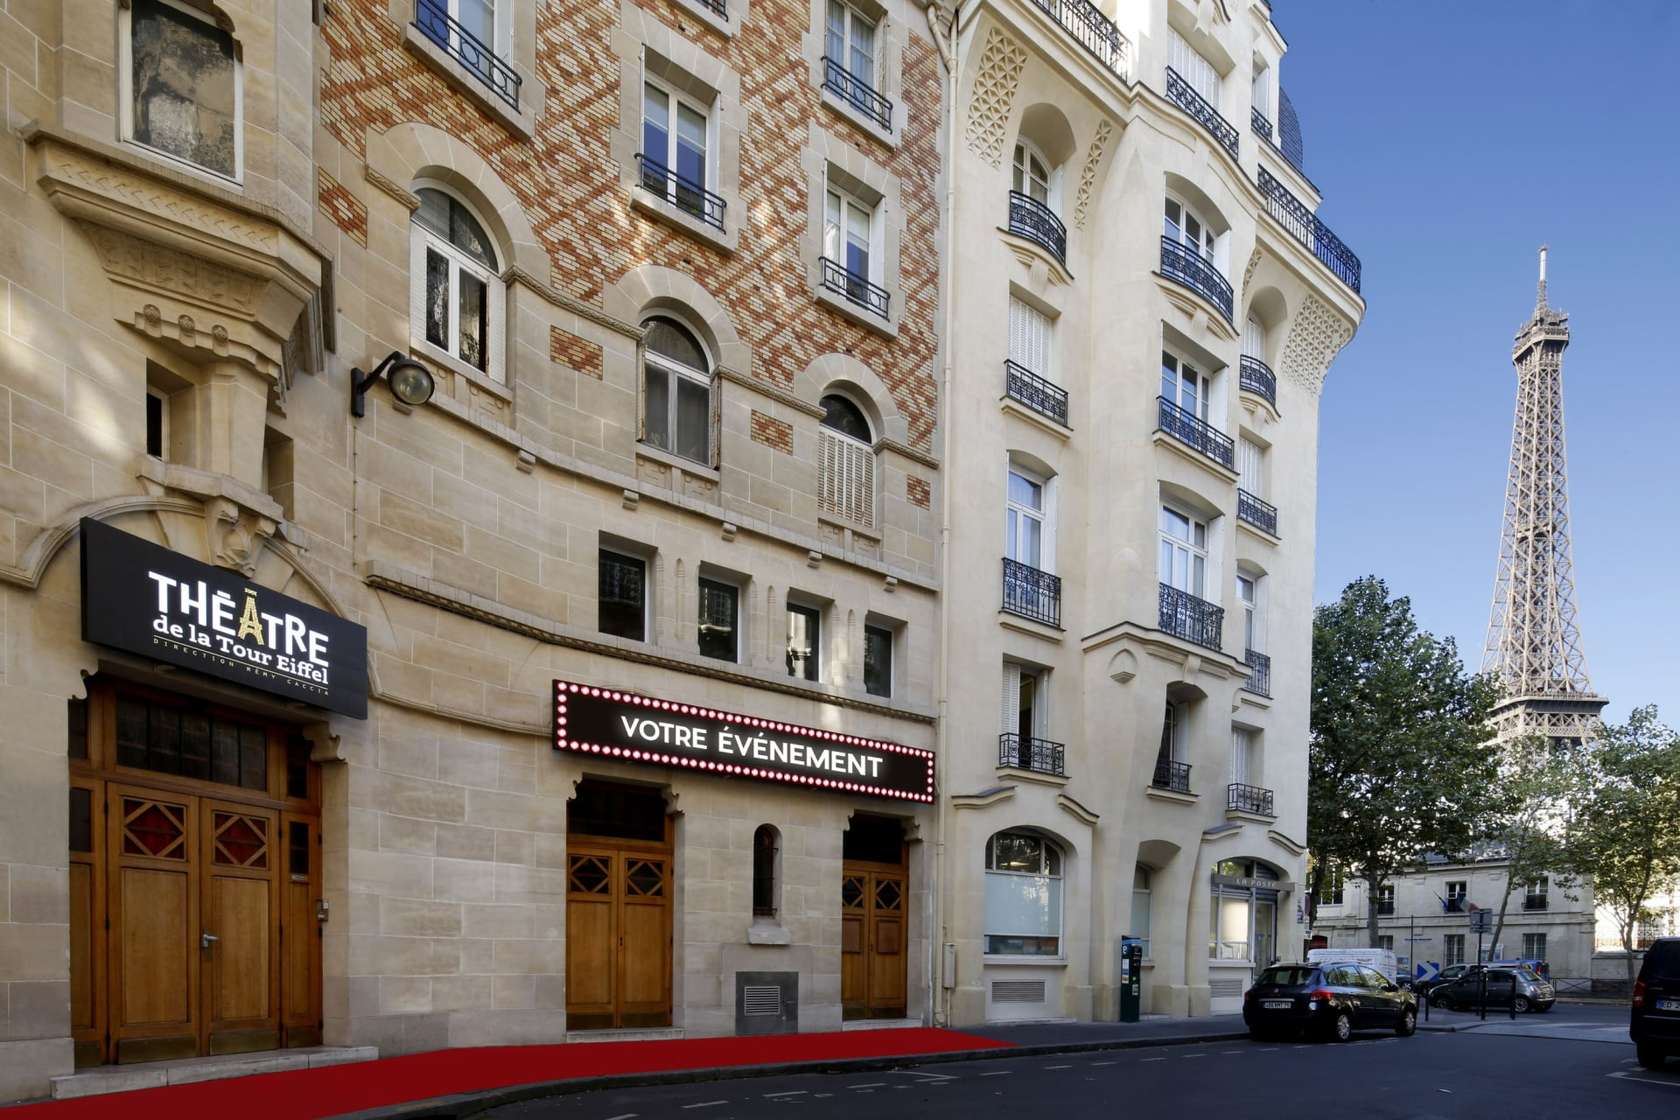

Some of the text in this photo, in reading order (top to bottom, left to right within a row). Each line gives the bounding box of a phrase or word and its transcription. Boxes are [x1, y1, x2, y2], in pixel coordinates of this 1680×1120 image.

[153, 614, 329, 685] de la Tour Eiffel
[153, 638, 234, 667] DIRECTION
[621, 715, 883, 778] VOTRE ÉVÉNEMENT
